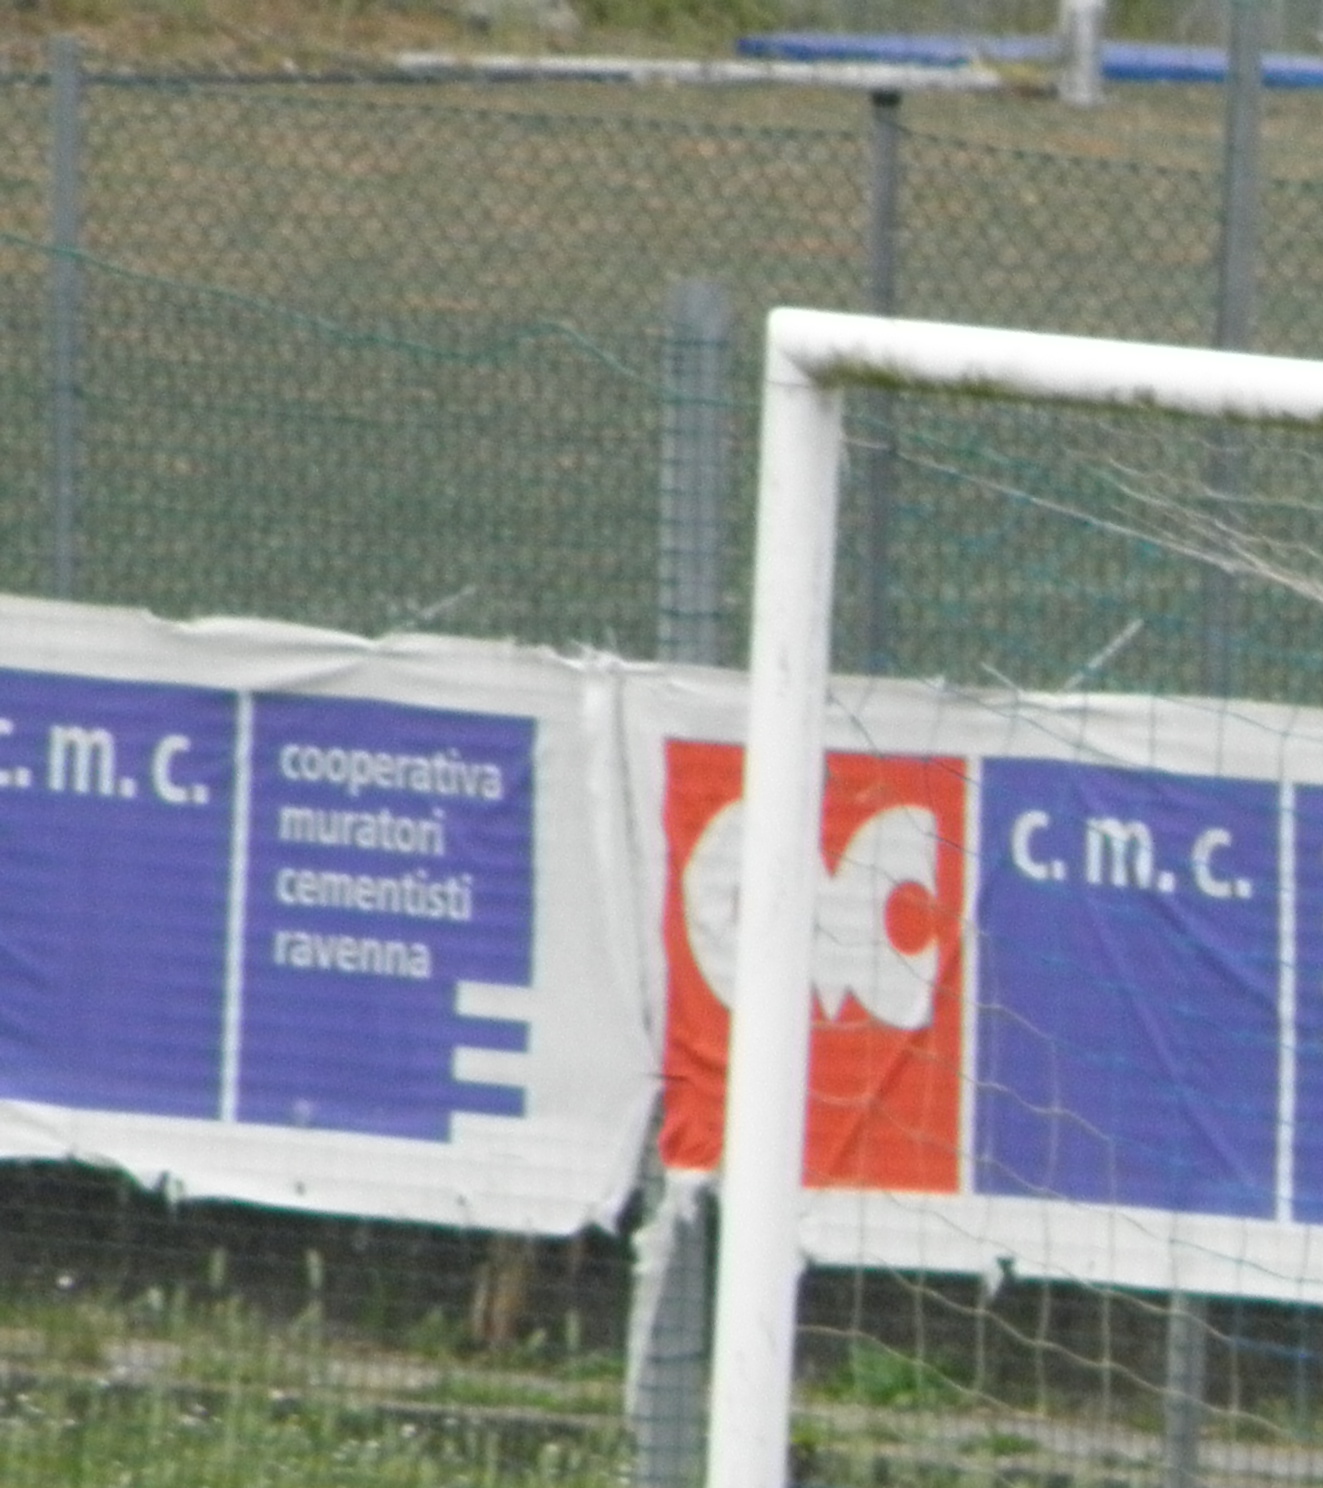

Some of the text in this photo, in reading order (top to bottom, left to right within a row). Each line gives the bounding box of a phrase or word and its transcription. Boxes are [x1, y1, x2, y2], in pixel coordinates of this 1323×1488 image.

[279, 744, 504, 801] cooperativa
[278, 807, 446, 856] muratori
[276, 868, 473, 922] cementisti
[273, 930, 432, 980] ravenna
